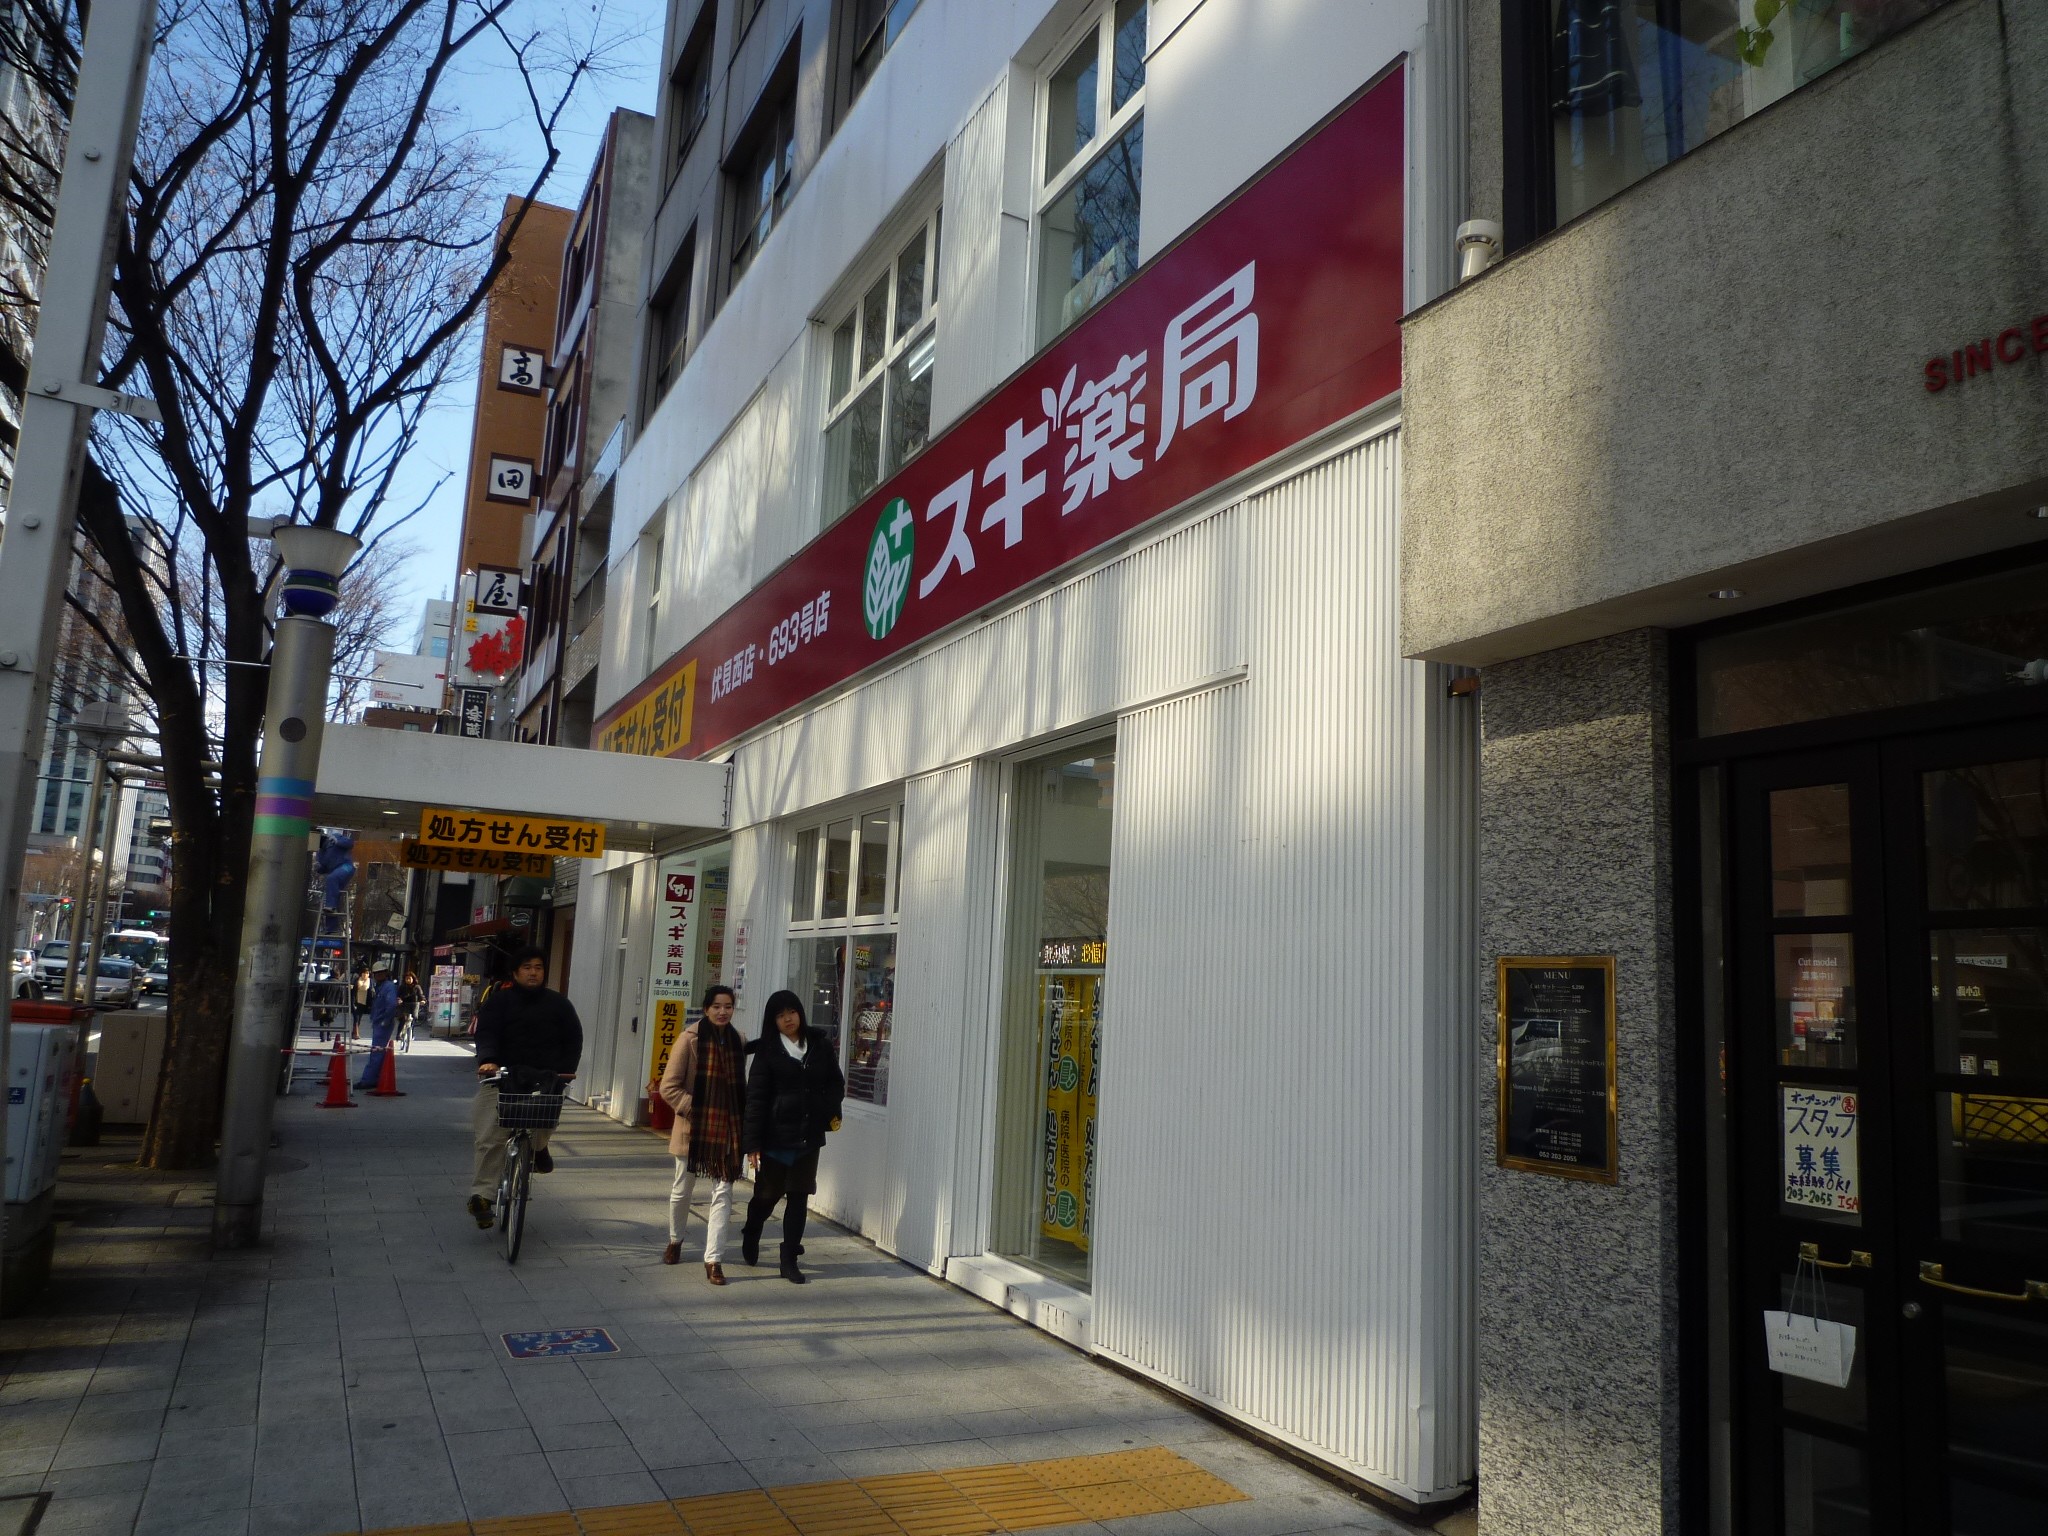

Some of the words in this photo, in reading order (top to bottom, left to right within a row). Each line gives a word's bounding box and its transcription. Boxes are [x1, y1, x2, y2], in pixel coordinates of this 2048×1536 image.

[1924, 314, 2048, 393] SINCE
[919, 259, 1260, 600] スギ薬局
[427, 814, 599, 853] 処方せん受付
[666, 906, 688, 976] スギ薬局
[1543, 971, 1571, 980] MENU
[1791, 1091, 1841, 1106] オープニング
[1787, 1106, 1856, 1138] スタッフ
[1795, 1144, 1842, 1178] 募集
[1787, 1186, 1833, 1206] 203-2055
